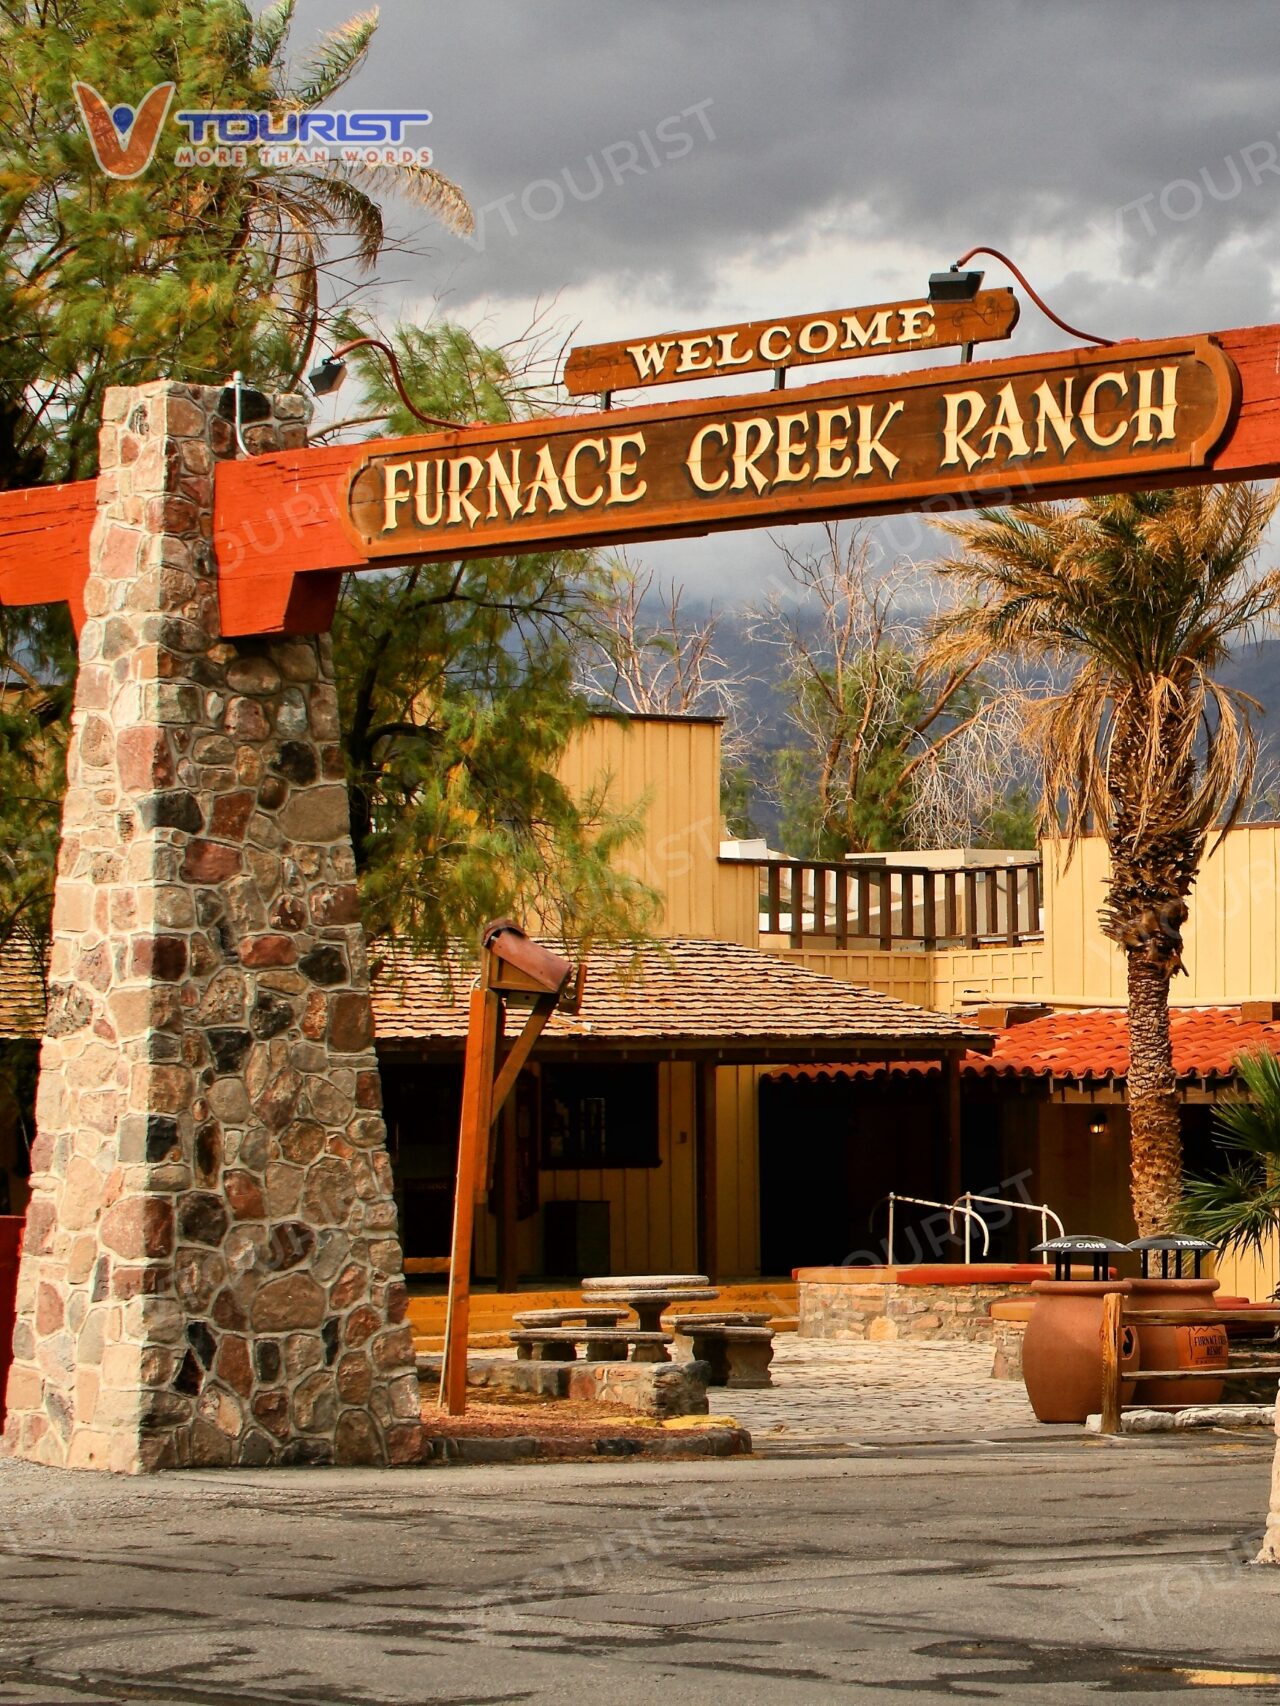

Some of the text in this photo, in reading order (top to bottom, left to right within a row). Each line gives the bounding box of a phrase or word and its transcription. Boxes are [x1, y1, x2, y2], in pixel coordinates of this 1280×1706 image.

[626, 304, 935, 380] WELCOME
[381, 366, 1180, 532] FURNACE CREEK RANCH
